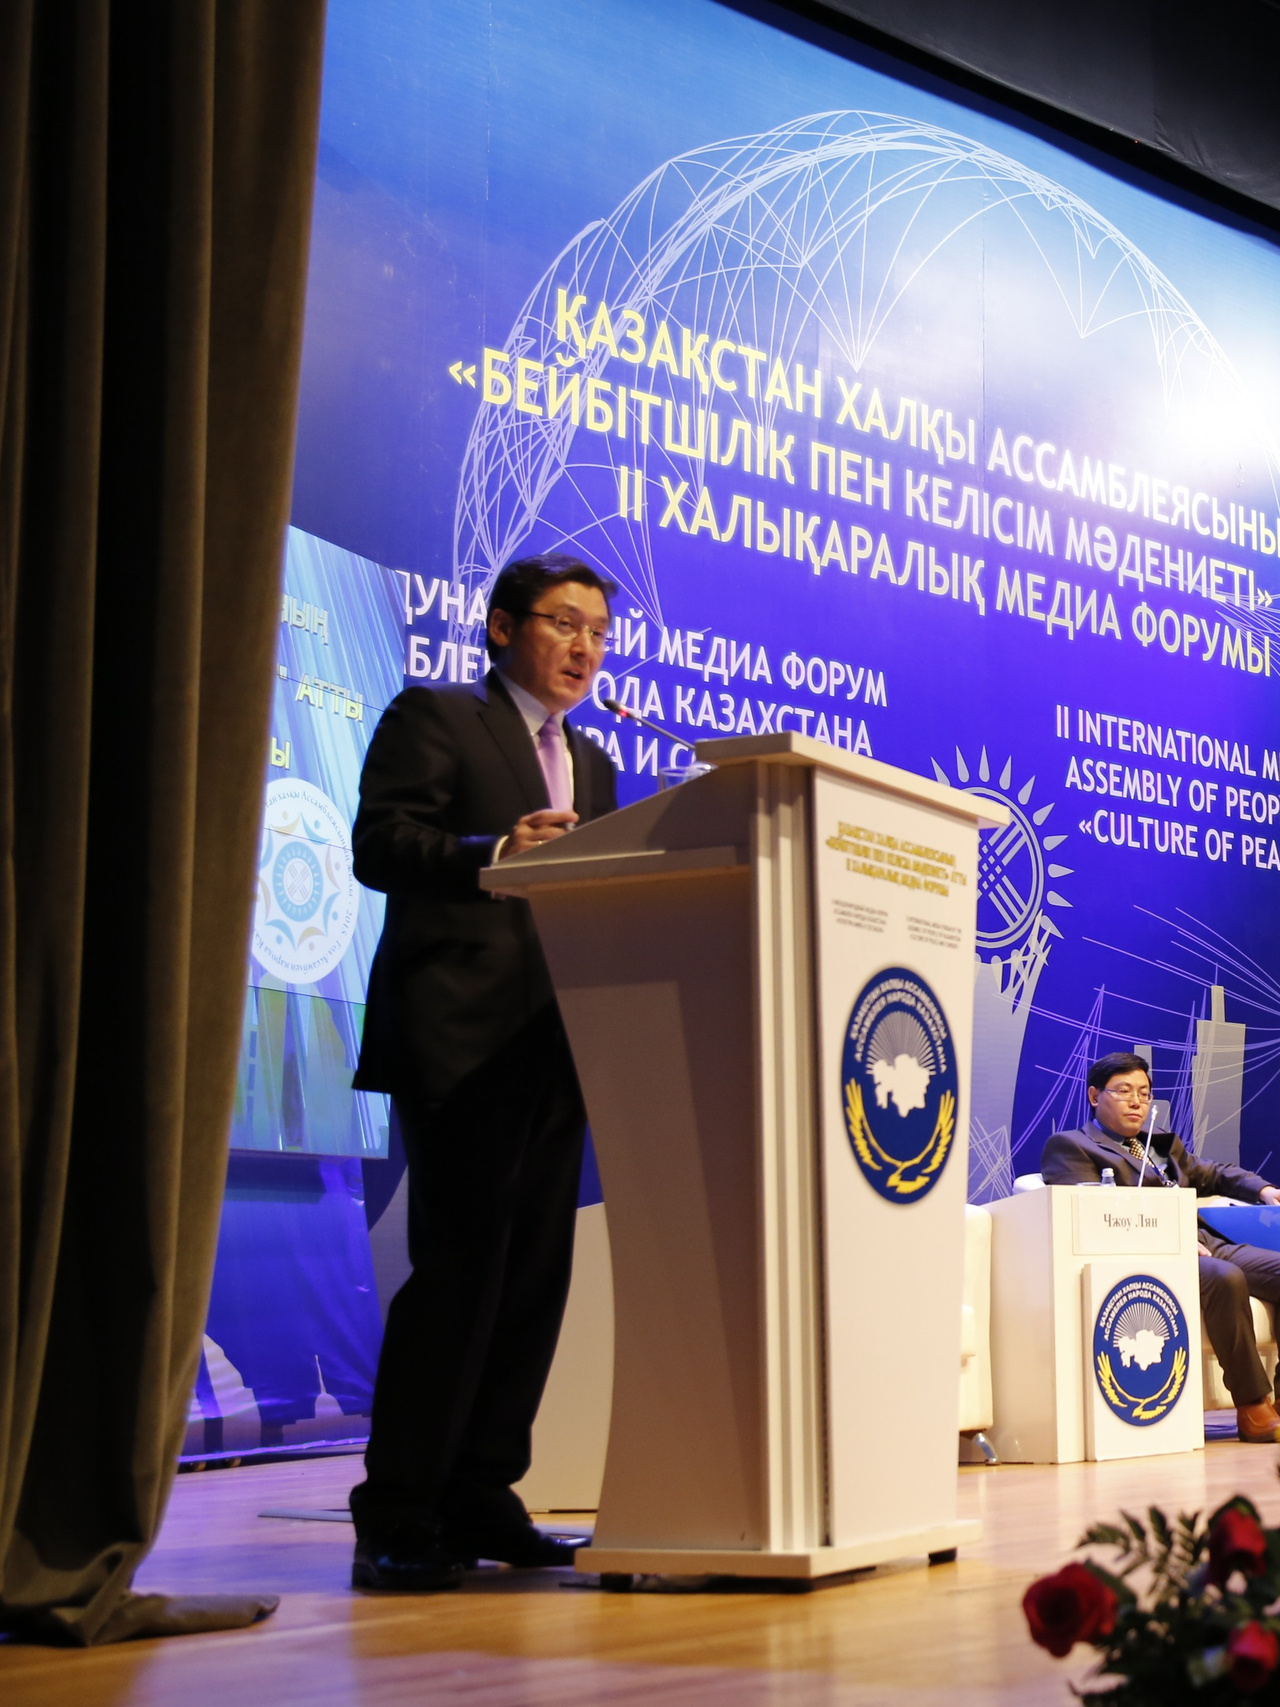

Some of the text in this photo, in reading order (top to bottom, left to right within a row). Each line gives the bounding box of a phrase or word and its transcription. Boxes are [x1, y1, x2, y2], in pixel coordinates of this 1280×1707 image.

[556, 287, 822, 418] ҚАЗАҚСТАН
[836, 376, 975, 465] ХАЛҚЫ
[448, 347, 795, 485] «БЕЙБІТШІЛІК
[811, 441, 891, 511] ПЕН
[905, 469, 1054, 557] КЕЛІСІМ
[1065, 517, 1273, 612] МӘДЕНИЕТІ»
[659, 475, 986, 616] ХАЛЫҚАРАЛЫҚ
[996, 566, 1122, 641] МЕДИА
[1132, 601, 1270, 677] ФОРУМЫ
[295, 673, 364, 723] АТТЫ
[658, 626, 773, 686] МЕДИА
[781, 651, 888, 708] ФОРУМ
[675, 684, 873, 757] КАЗАХСТАНА
[1077, 709, 1257, 777] INTERNATIONAL
[636, 734, 659, 777] И
[1064, 755, 1182, 807] ASSEMBLY
[1188, 779, 1218, 814] OF
[1078, 809, 1199, 858] «CULTURE
[1204, 828, 1235, 862] OF
[1103, 1213, 1158, 1231] Чжоу Лян
